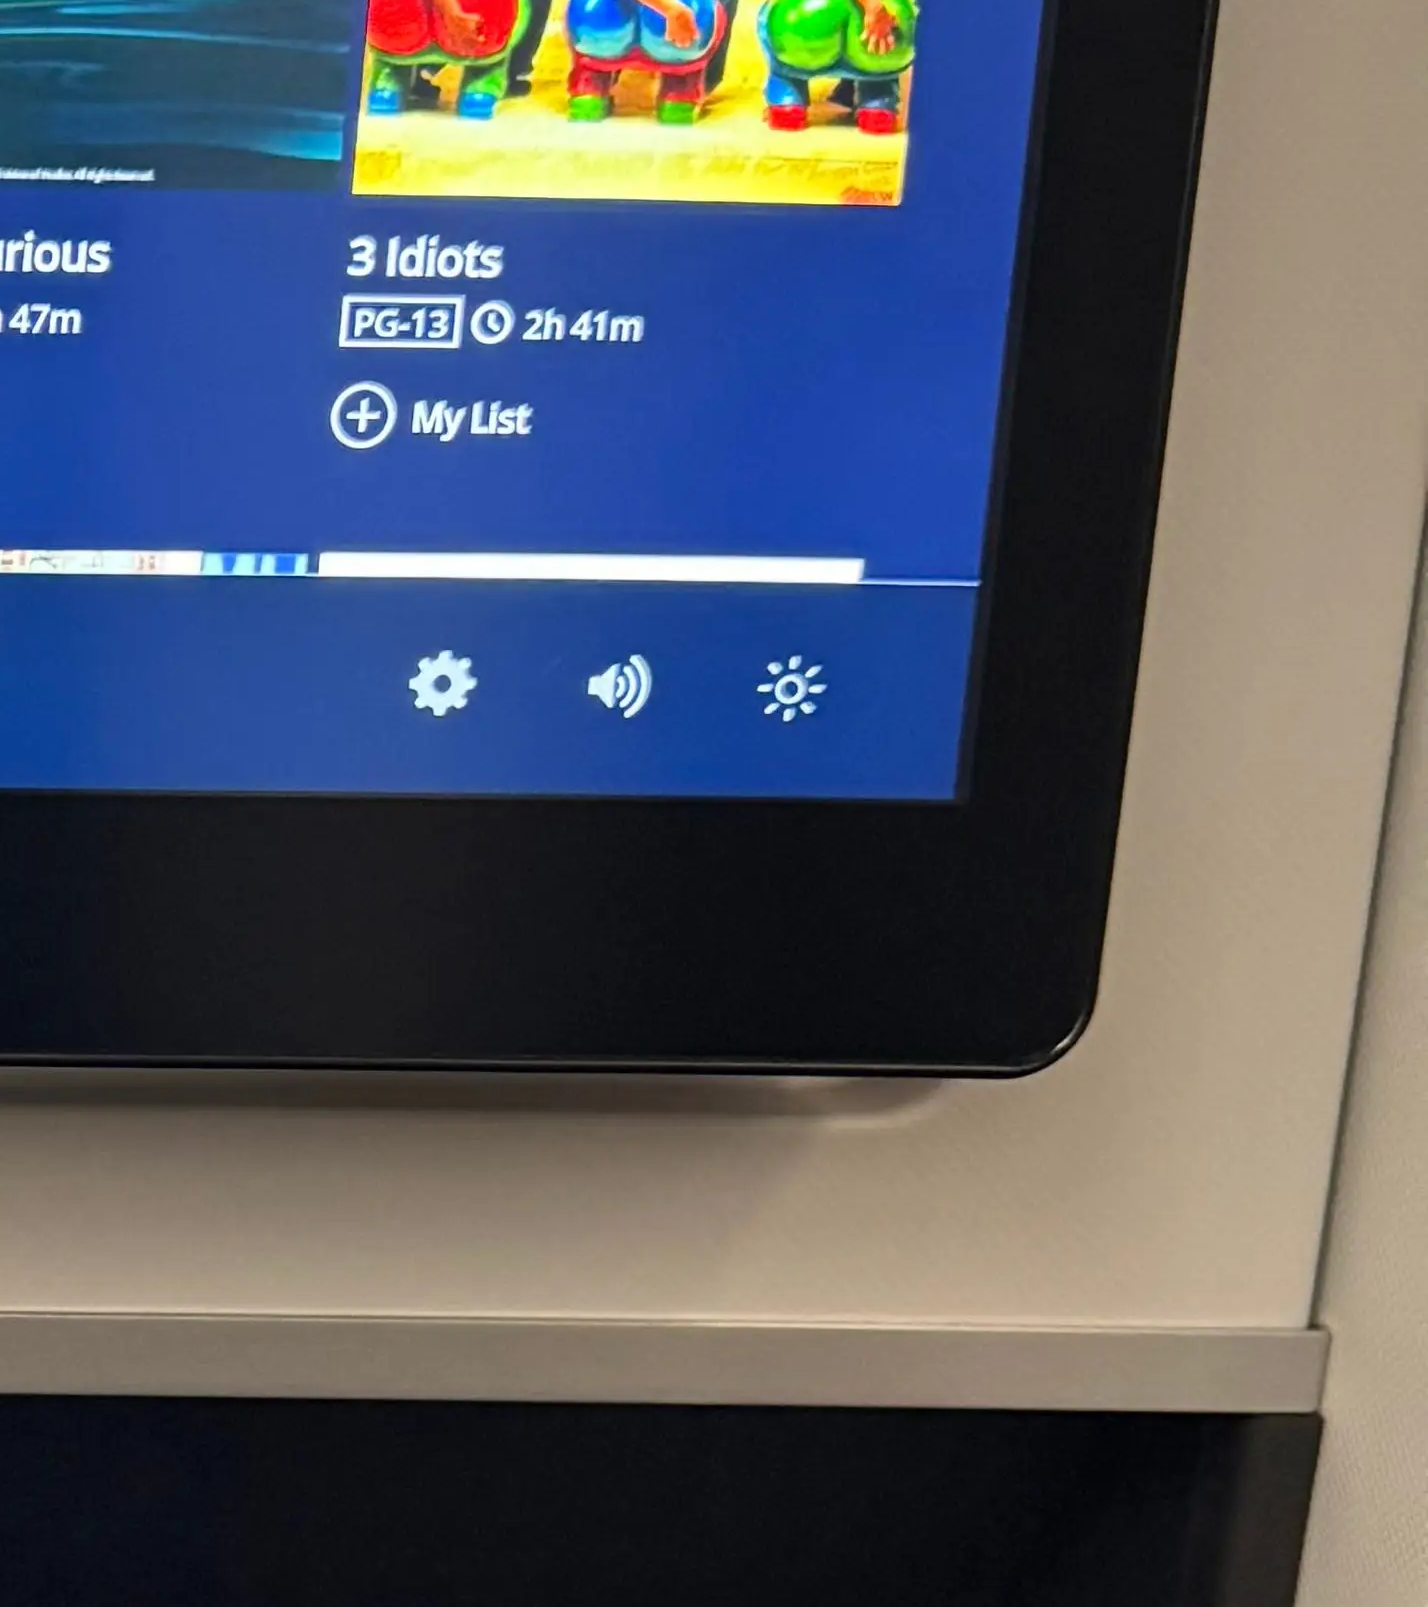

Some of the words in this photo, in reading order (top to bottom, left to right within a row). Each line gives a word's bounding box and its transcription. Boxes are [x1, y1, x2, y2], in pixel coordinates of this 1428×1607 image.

[347, 236, 376, 276] 3
[386, 235, 503, 278] Idiots
[9, 304, 81, 334] 47m
[352, 311, 449, 339] PG-13
[523, 309, 565, 340] 2h
[570, 310, 643, 342] 41m
[412, 401, 466, 441] My
[471, 401, 532, 434] List
